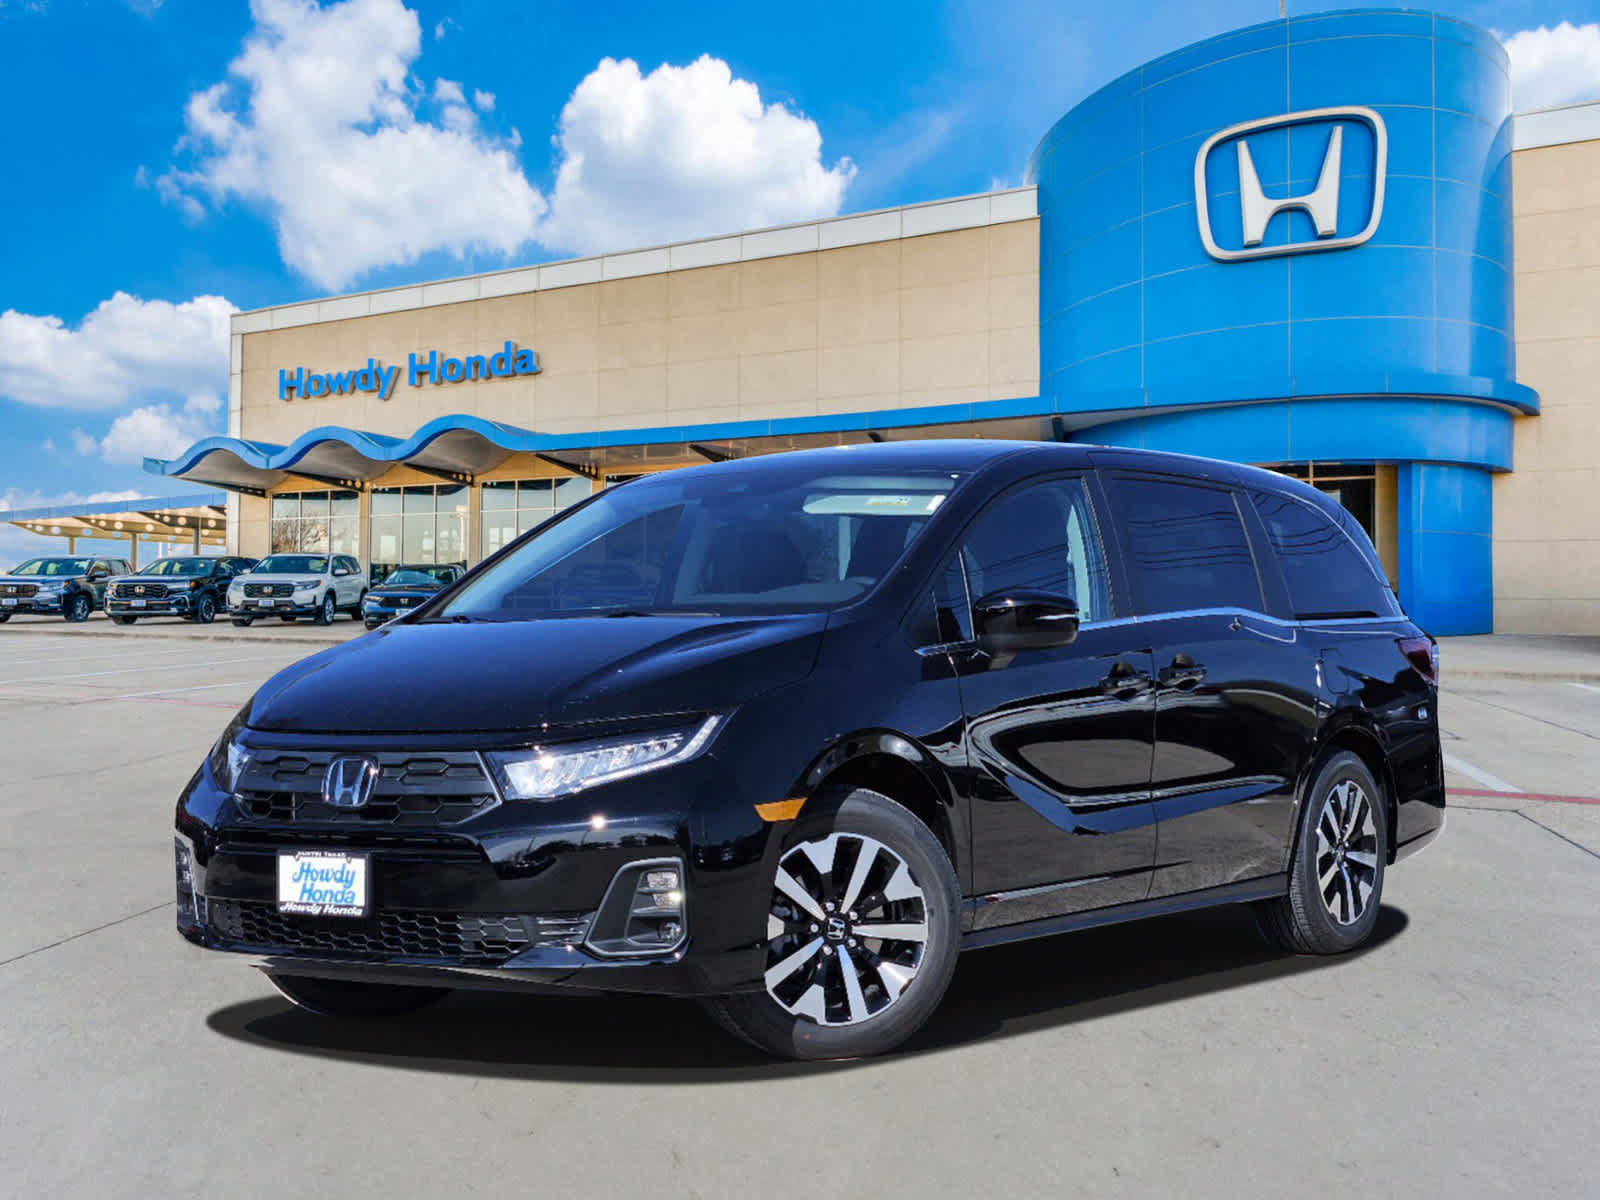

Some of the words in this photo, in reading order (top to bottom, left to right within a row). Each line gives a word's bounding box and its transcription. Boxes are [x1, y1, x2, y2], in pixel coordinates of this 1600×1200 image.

[278, 357, 400, 401] Howdy
[408, 340, 543, 388] Honda
[291, 861, 357, 890] Howdy
[299, 881, 356, 905] Honda
[280, 901, 322, 916] Howdy
[323, 902, 363, 917] Honda
